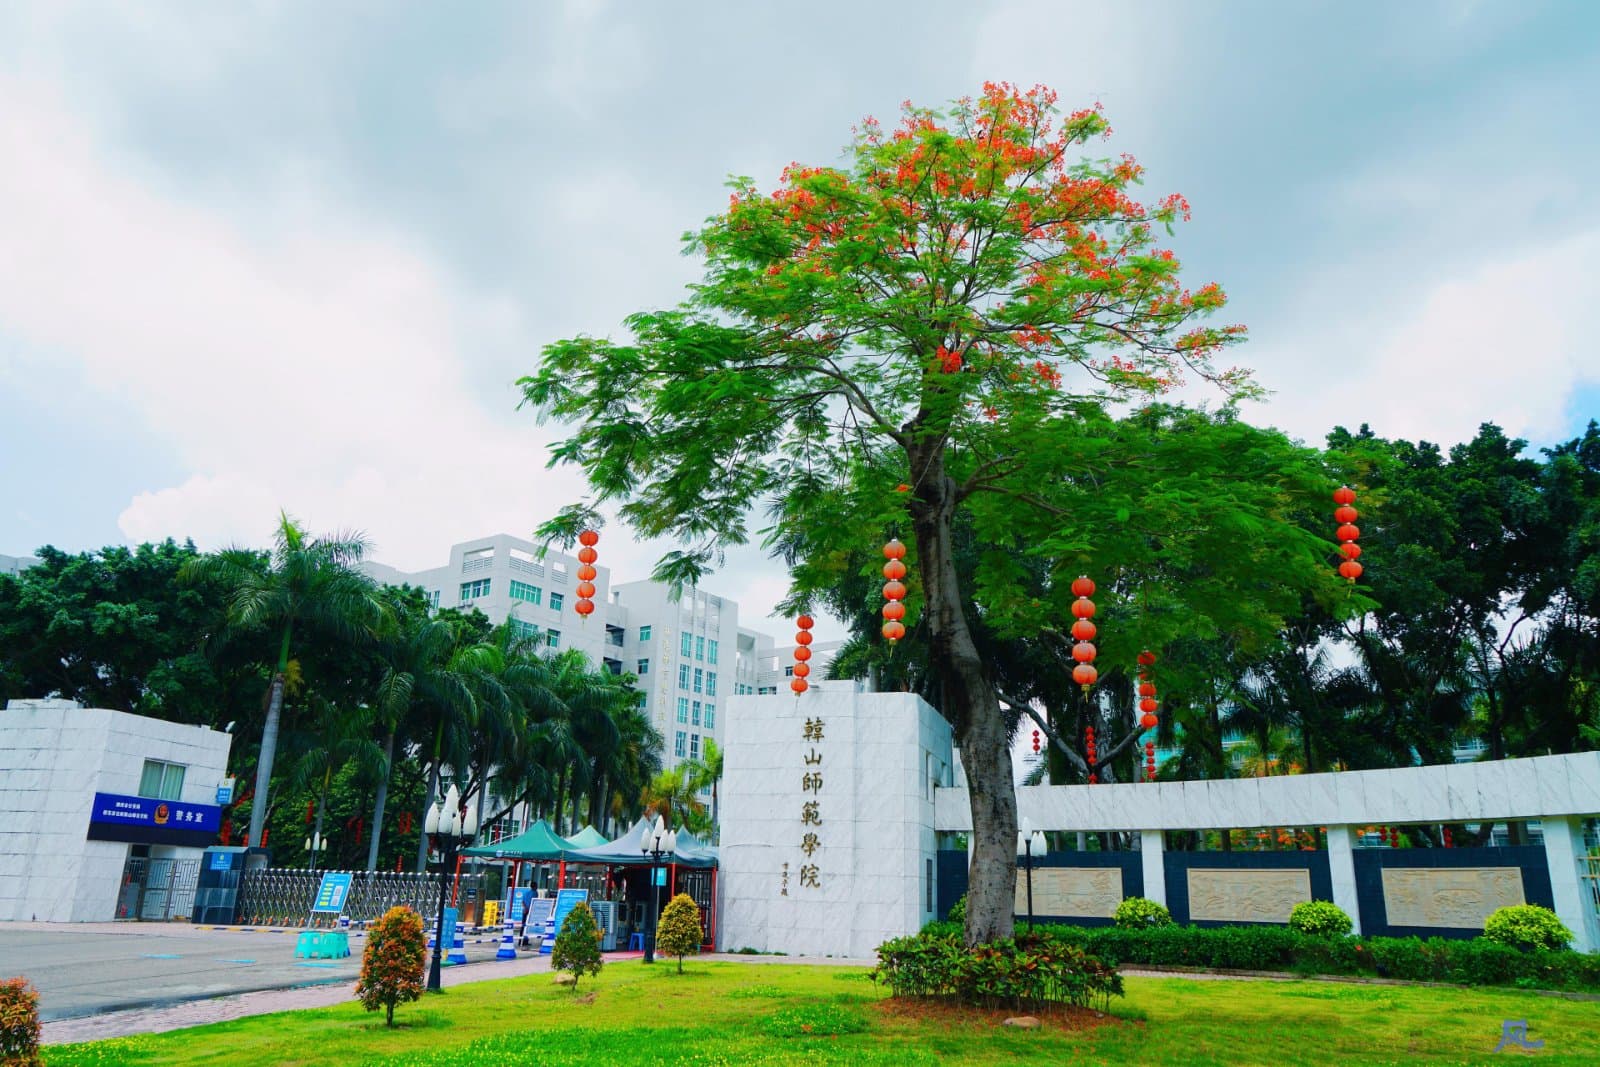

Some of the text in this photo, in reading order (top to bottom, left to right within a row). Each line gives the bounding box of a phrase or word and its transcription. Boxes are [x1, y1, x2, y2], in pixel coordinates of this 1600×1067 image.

[175, 809, 204, 823] 警务室
[799, 716, 826, 889] 韓山師範學院
